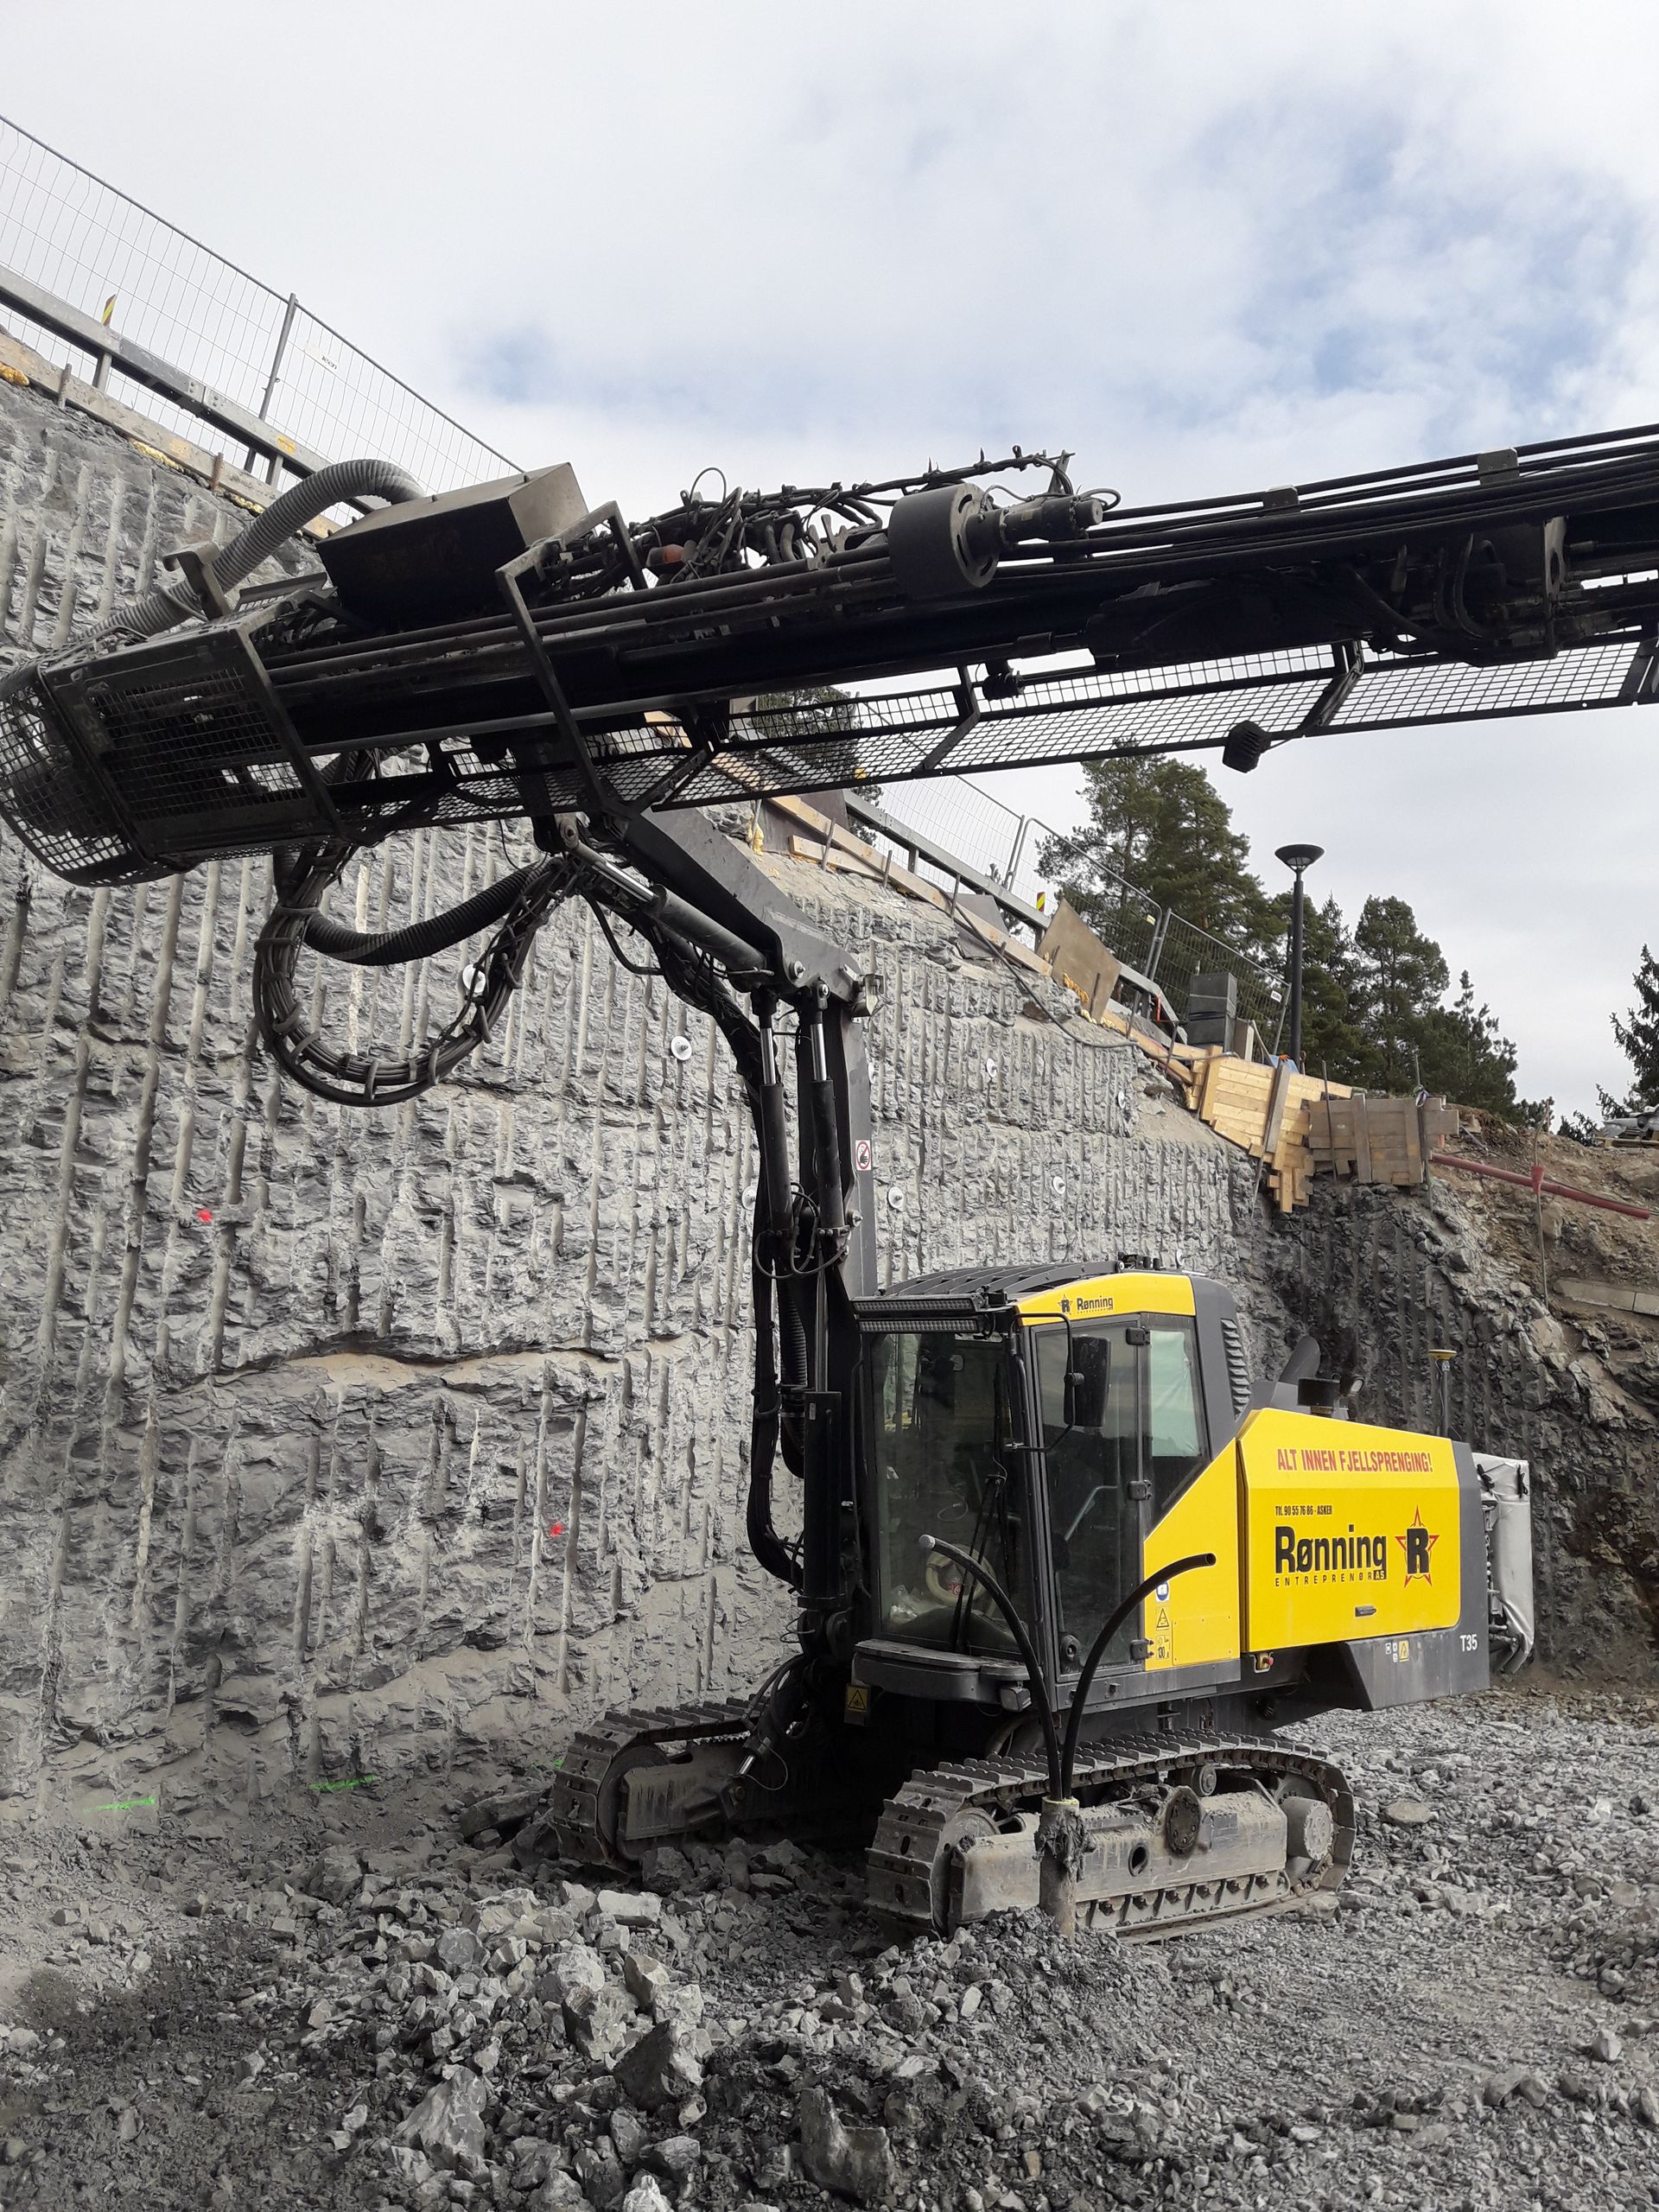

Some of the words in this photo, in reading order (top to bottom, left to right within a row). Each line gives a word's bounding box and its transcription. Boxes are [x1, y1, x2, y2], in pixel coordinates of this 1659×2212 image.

[1077, 1295, 1113, 1310] Rønning
[1277, 1448, 1297, 1471] ALT
[1300, 1449, 1338, 1471] INNEN
[1339, 1450, 1433, 1473] FJELLSPRENGING!
[1292, 1505, 1299, 1516] 55
[1300, 1505, 1306, 1516] 76
[1274, 1524, 1387, 1574] Rønning
[1407, 1528, 1429, 1574] R
[1374, 1570, 1387, 1580] AS
[1459, 1634, 1478, 1652] T35
